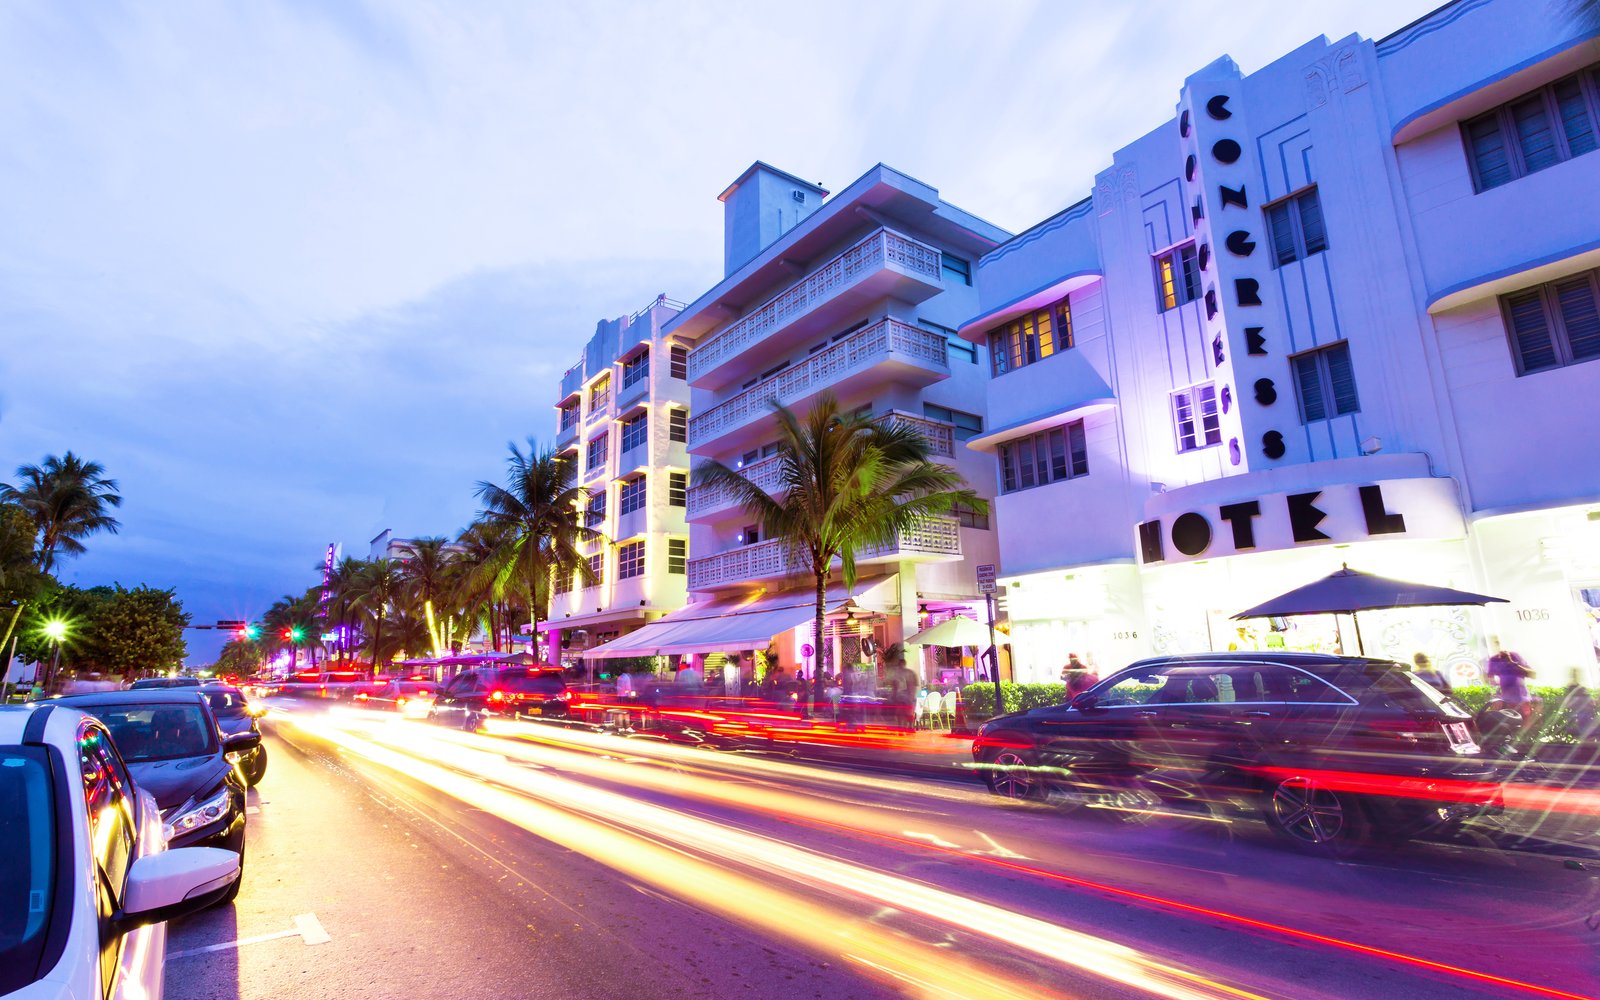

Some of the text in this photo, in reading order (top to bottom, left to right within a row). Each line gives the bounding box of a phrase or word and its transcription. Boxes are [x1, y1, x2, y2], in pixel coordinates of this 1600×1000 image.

[1207, 94, 1287, 460] CONGRESS
[1516, 609, 1549, 621] 1036
[1113, 631, 1137, 639] 1036
